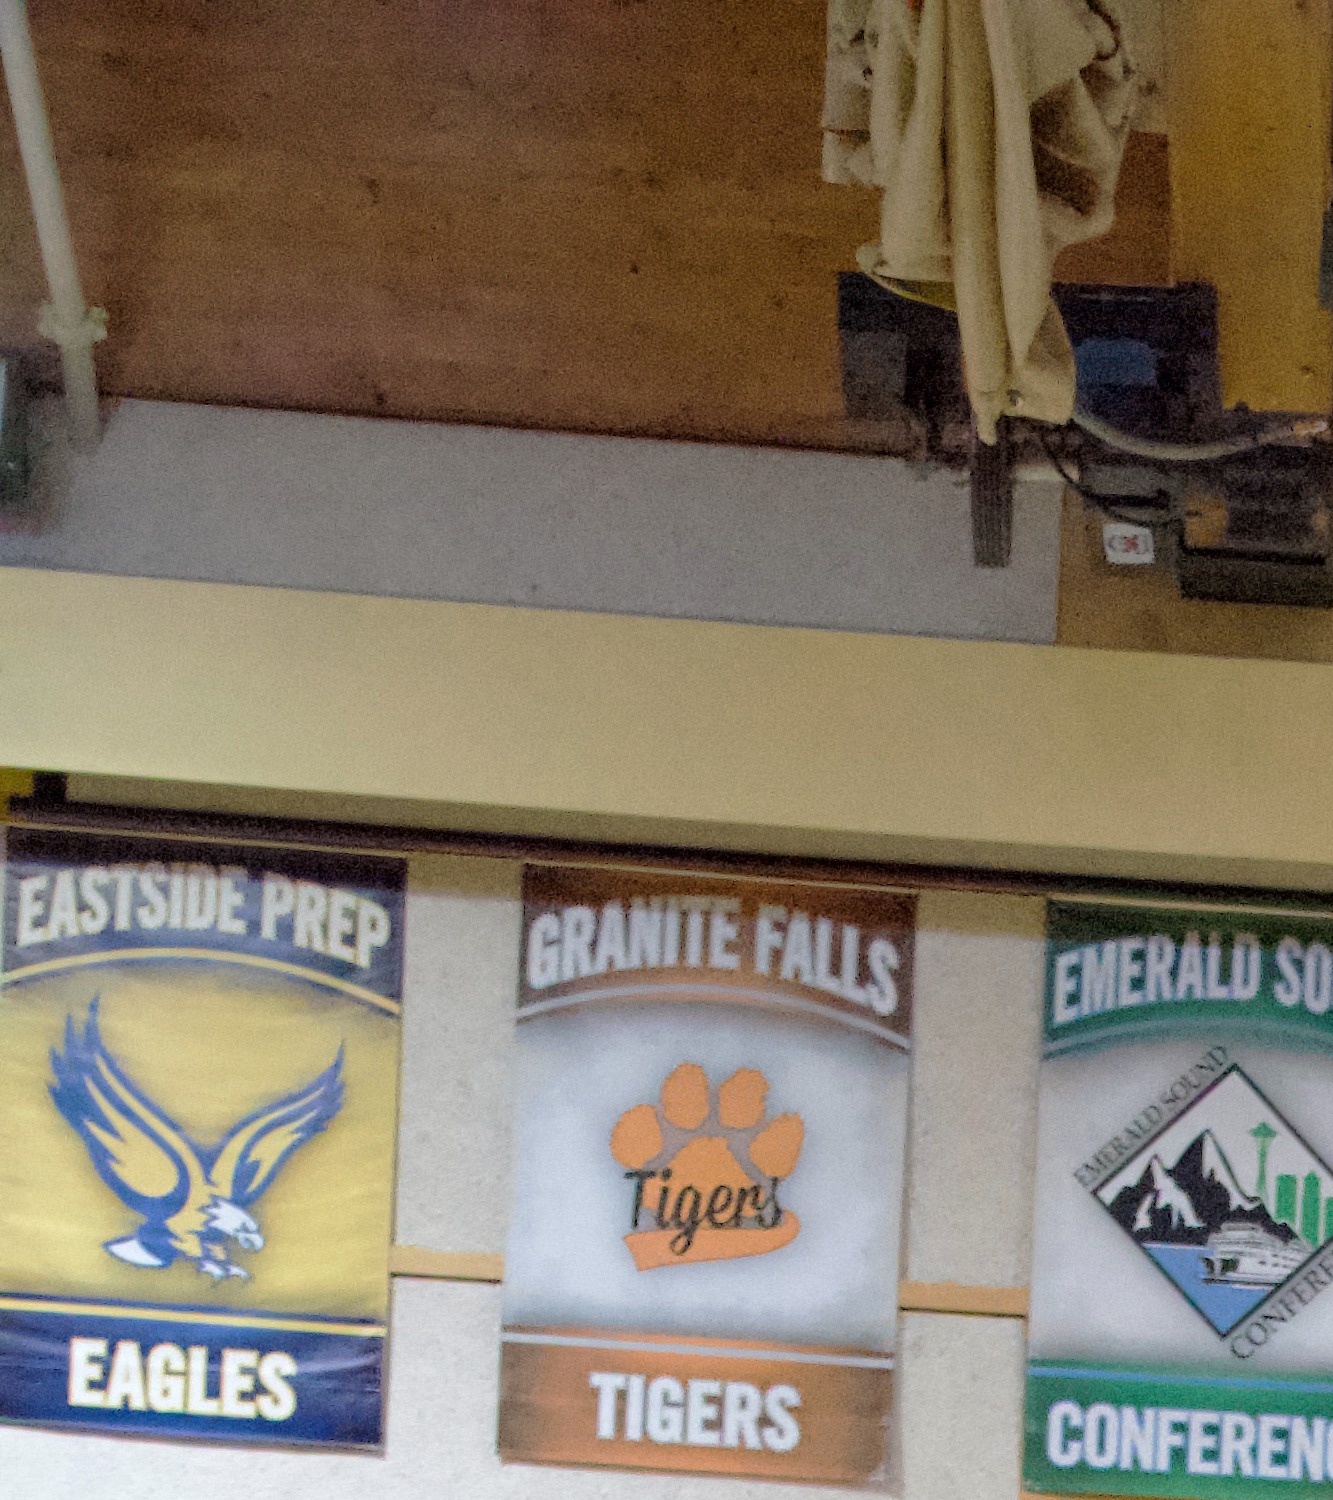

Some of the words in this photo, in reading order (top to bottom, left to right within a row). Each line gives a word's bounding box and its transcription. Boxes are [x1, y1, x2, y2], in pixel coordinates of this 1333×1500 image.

[16, 864, 247, 949] EASTSIDE
[261, 877, 392, 970] PREP
[526, 898, 740, 991] GRANITE
[755, 904, 899, 1017] FALLS
[1052, 934, 1262, 1028] EMERALD
[1073, 1103, 1162, 1189] EMERALD
[1158, 1045, 1228, 1113] SOUND
[623, 1167, 783, 1256] Tigers
[68, 1336, 298, 1423] EAGLES
[589, 1372, 803, 1454] TIGERS
